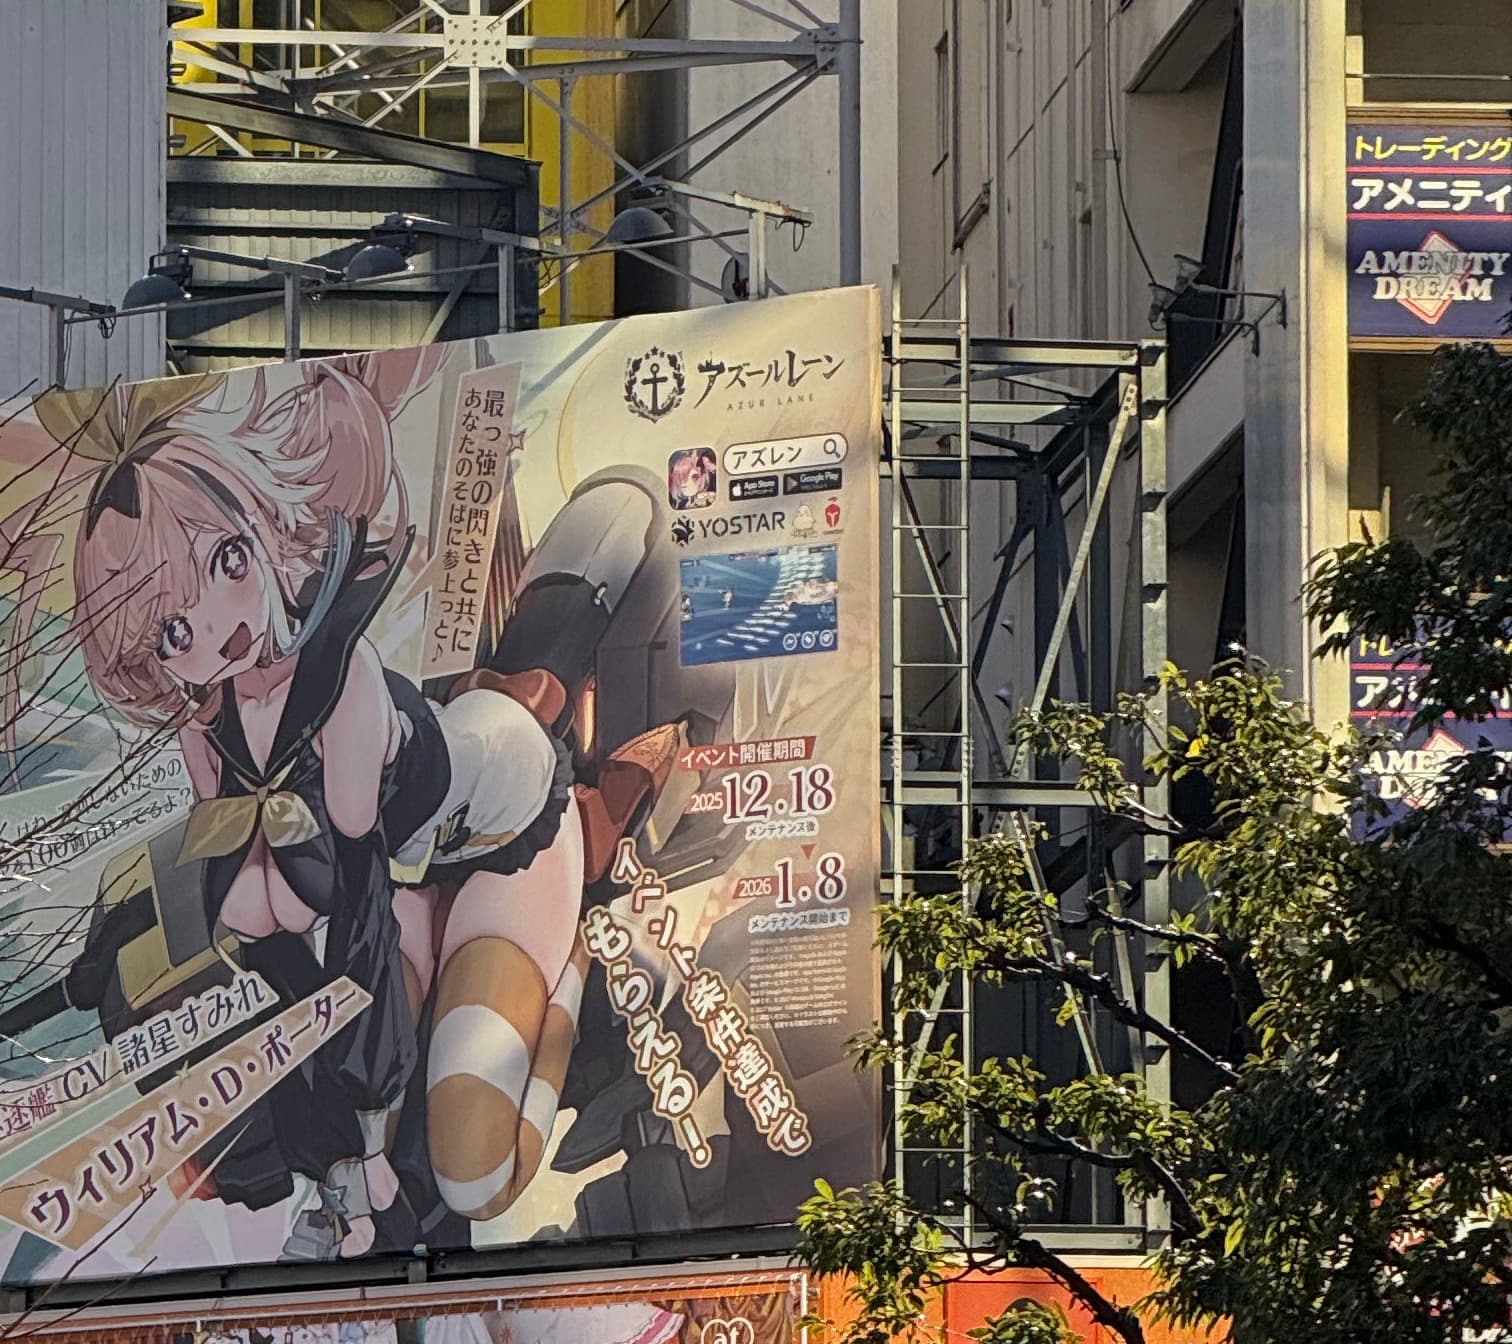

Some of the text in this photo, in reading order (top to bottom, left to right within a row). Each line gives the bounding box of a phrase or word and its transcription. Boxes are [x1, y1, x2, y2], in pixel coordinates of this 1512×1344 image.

[1355, 135, 1512, 162] トレーディング
[1351, 178, 1512, 213] アメニティ
[1355, 250, 1510, 276] AMENITY
[1373, 276, 1493, 301] DREAM
[694, 350, 845, 409] アズールレーン
[727, 392, 816, 412] AZUR LANE
[732, 447, 802, 470] アズレン
[451, 389, 506, 653] 最っ強の閃きと共に
[699, 511, 786, 539] YOSTAR
[681, 739, 806, 769] イベント開催期間
[691, 791, 724, 813] 2025
[747, 820, 816, 837] メンテナンス後
[738, 877, 773, 897] 2026
[750, 910, 849, 931] メンテナンス開始まで
[613, 840, 810, 1153] イベント条件達成で
[63, 1053, 109, 1103] CV
[118, 976, 267, 1076] 諸星すみれ
[29, 987, 360, 1235] ウィリアム・D・ポーター
